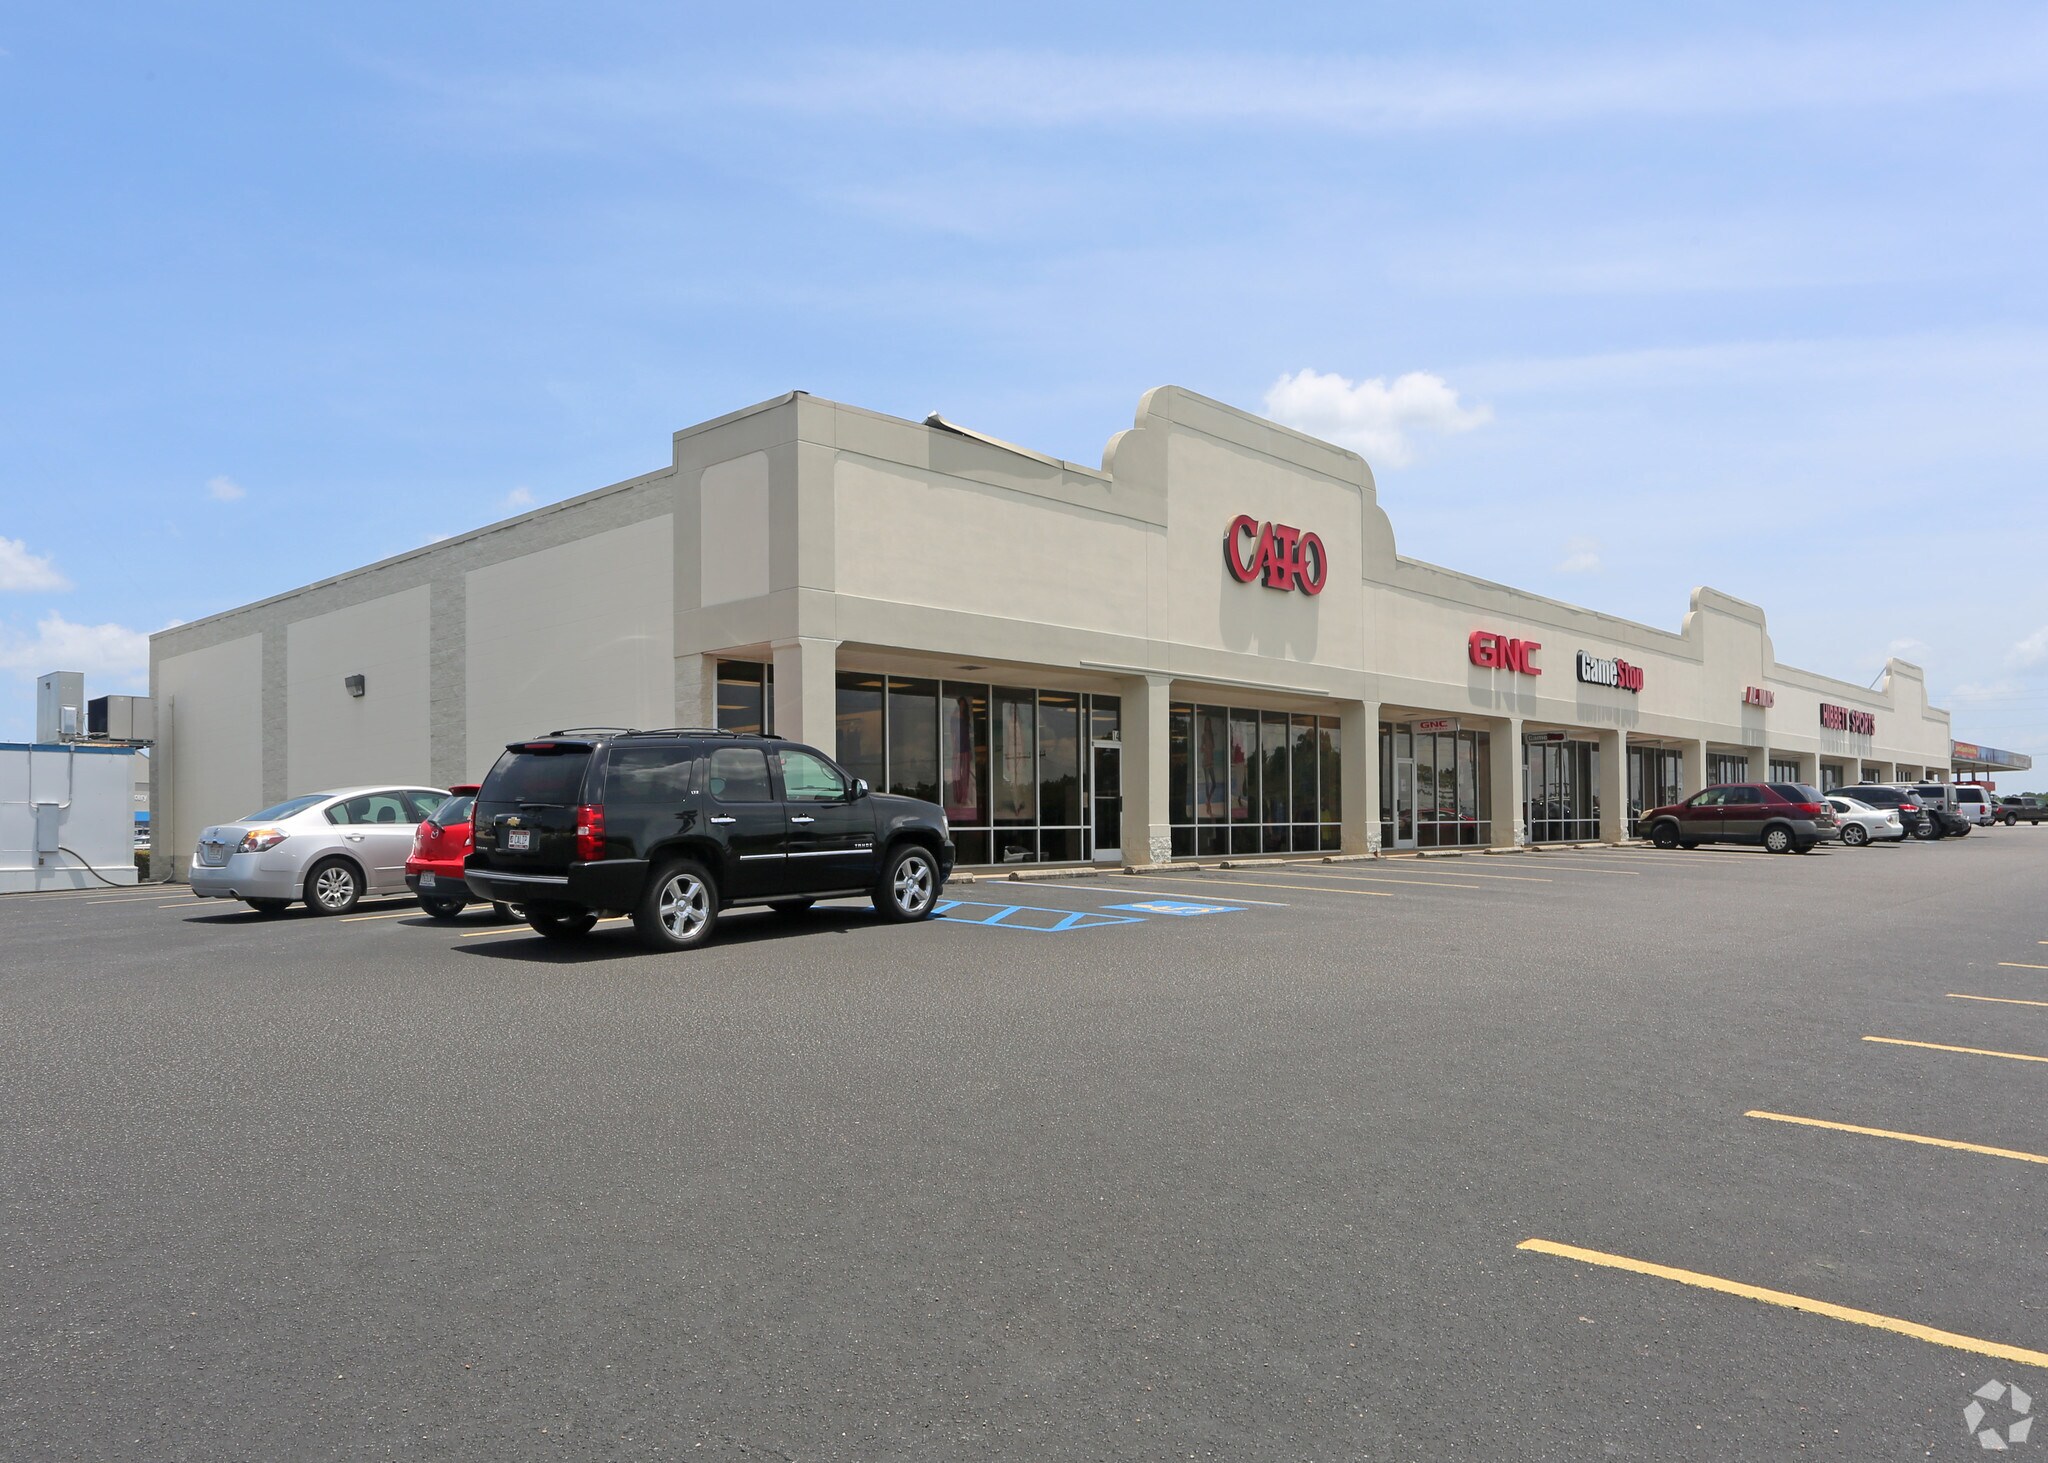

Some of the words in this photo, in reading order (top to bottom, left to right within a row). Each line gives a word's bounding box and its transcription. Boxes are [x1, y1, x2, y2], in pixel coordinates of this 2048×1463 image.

[1223, 514, 1327, 596] CATO
[1468, 630, 1542, 676] GNC
[1577, 650, 1644, 694] GameStop
[1420, 720, 1448, 729] GNC
[1528, 733, 1564, 741] Game
[1820, 703, 1848, 731] HIBBETT
[1849, 709, 1876, 736] SPORTS
